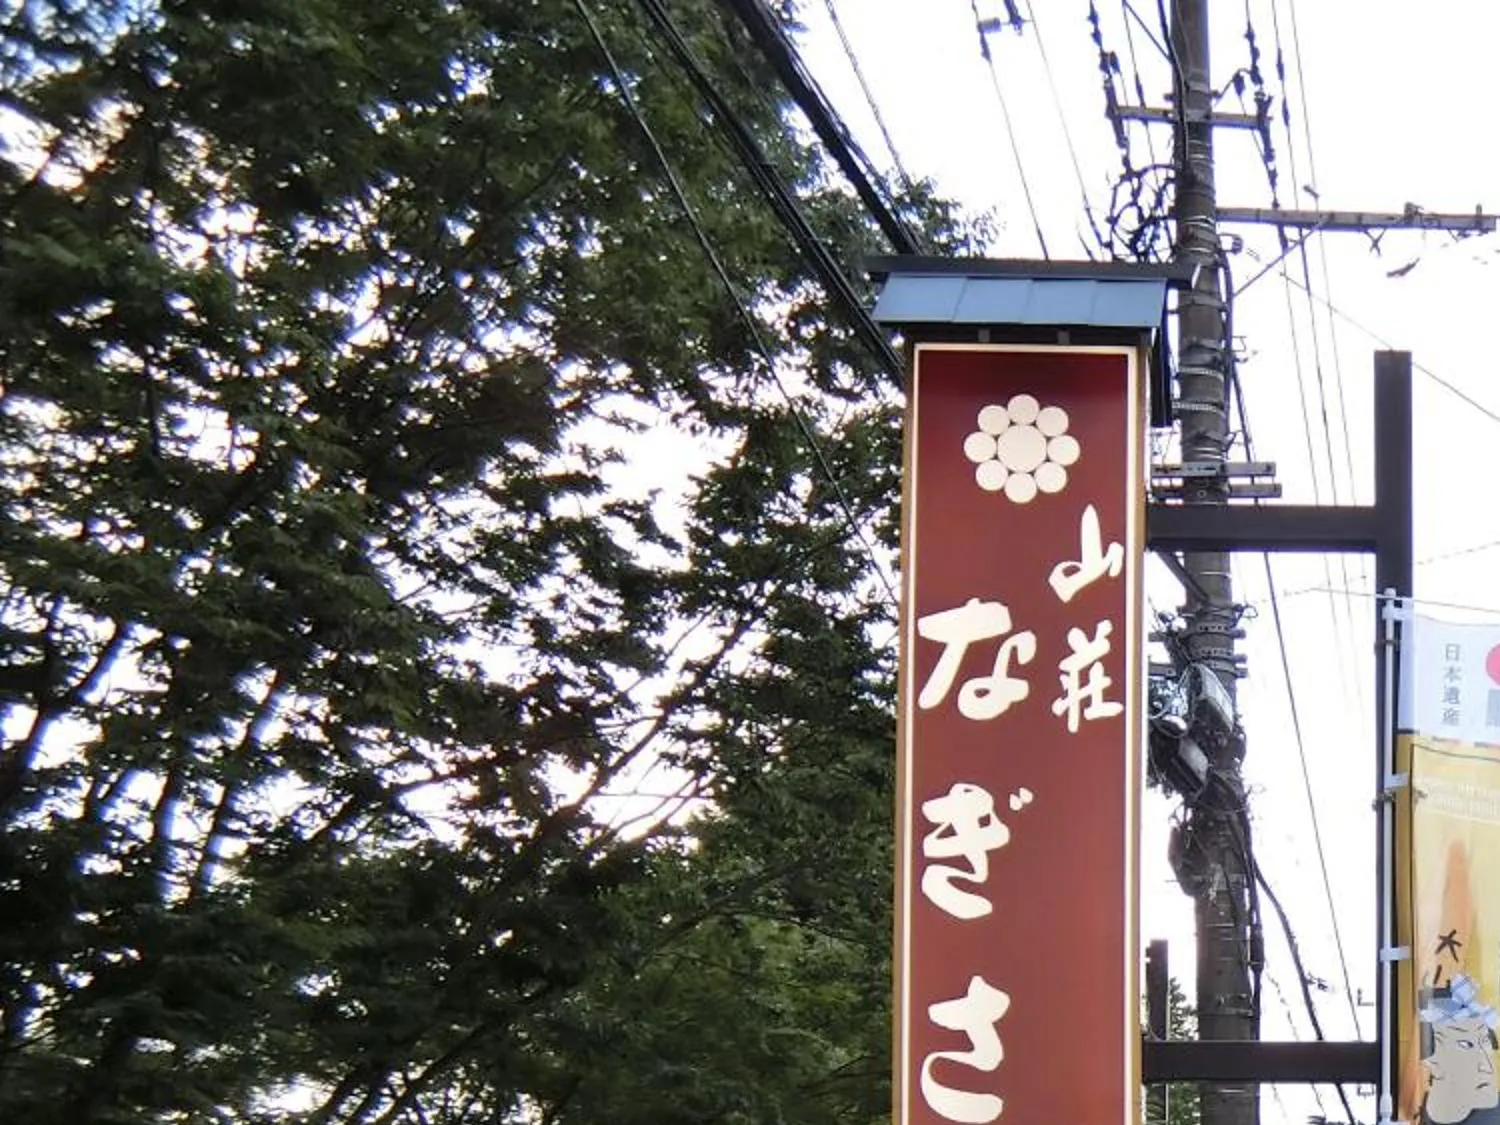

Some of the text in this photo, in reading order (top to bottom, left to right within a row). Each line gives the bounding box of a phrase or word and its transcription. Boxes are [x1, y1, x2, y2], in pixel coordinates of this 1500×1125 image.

[1047, 503, 1124, 734] 山荘
[1441, 642, 1462, 727] 日本遺産
[917, 597, 1037, 1125] なぎさ
